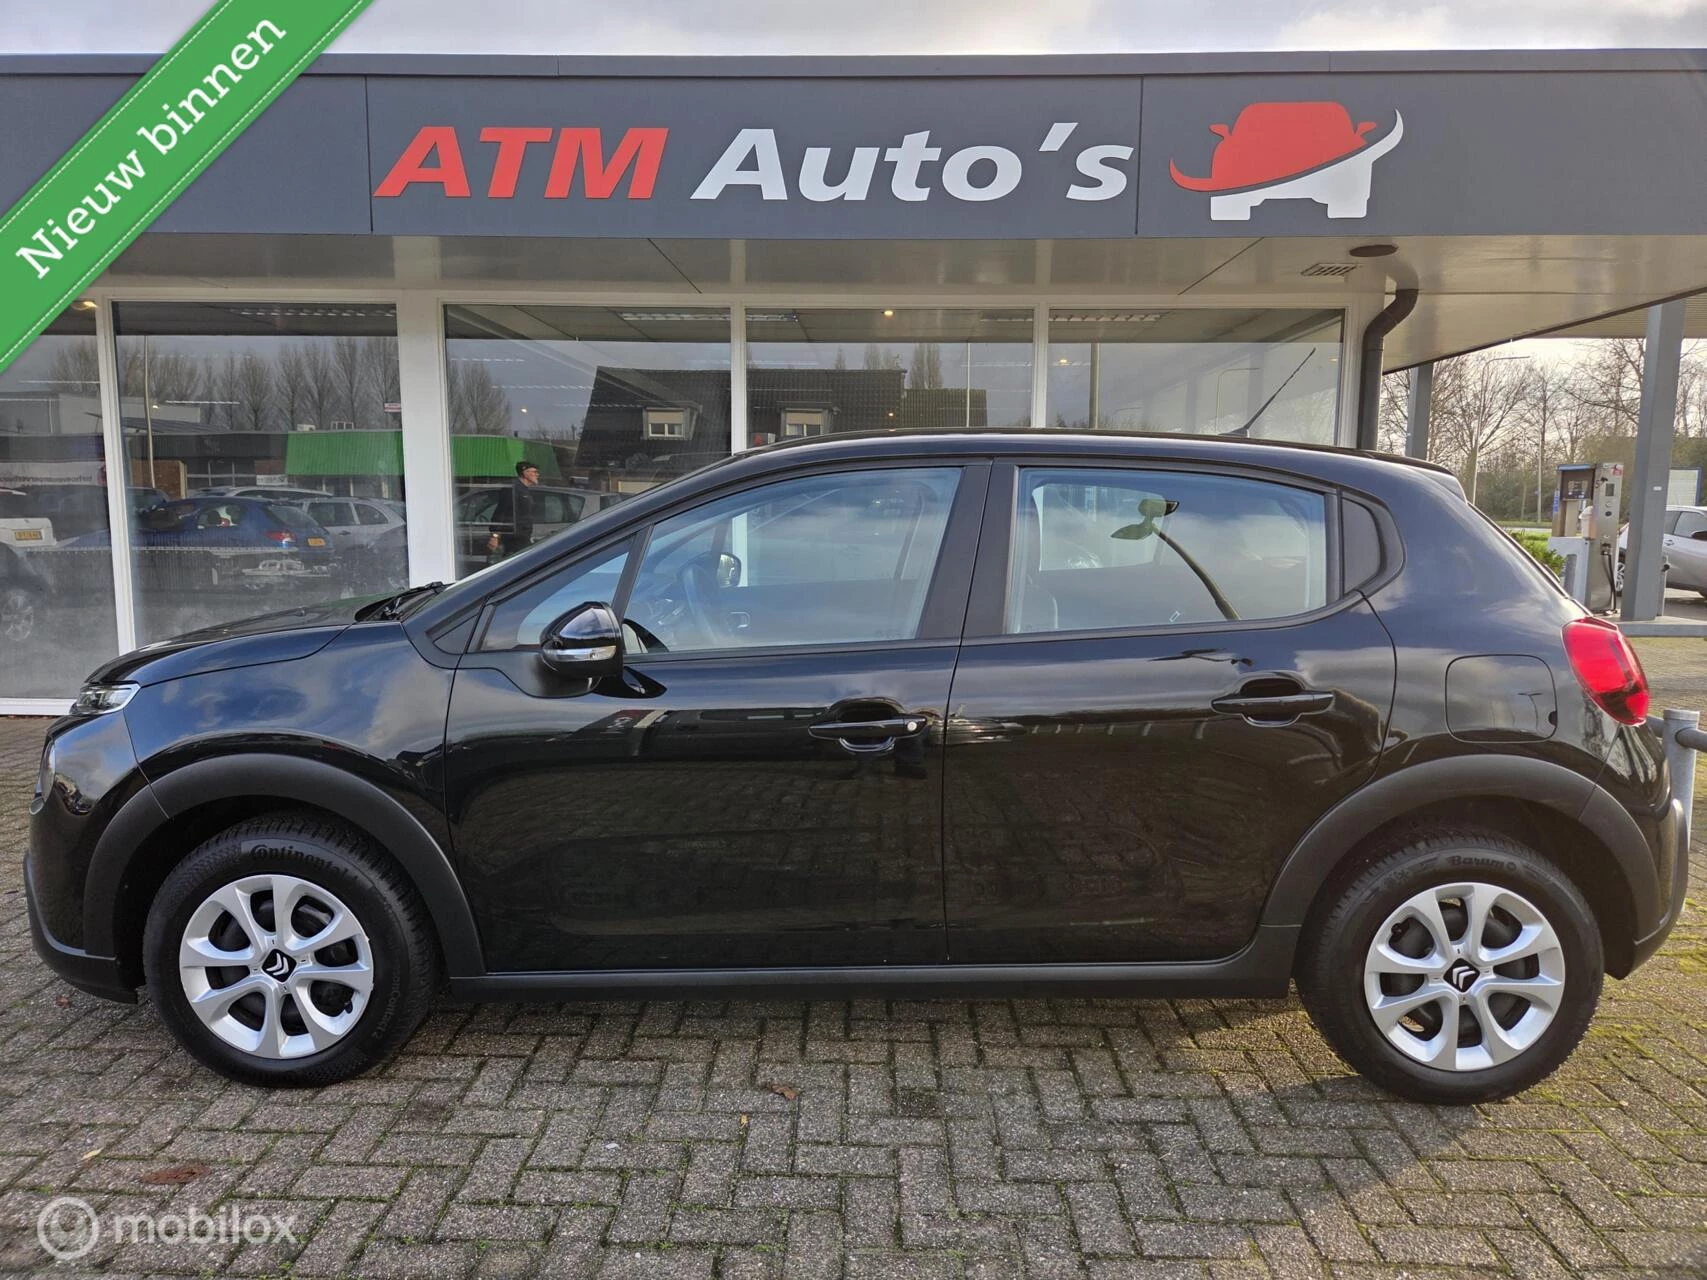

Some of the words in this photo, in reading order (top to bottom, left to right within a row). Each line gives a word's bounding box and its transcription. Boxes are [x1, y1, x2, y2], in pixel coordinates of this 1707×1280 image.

[373, 126, 669, 199] ATM
[690, 121, 1135, 202] Auto's
[1447, 855, 1505, 868] Barum
